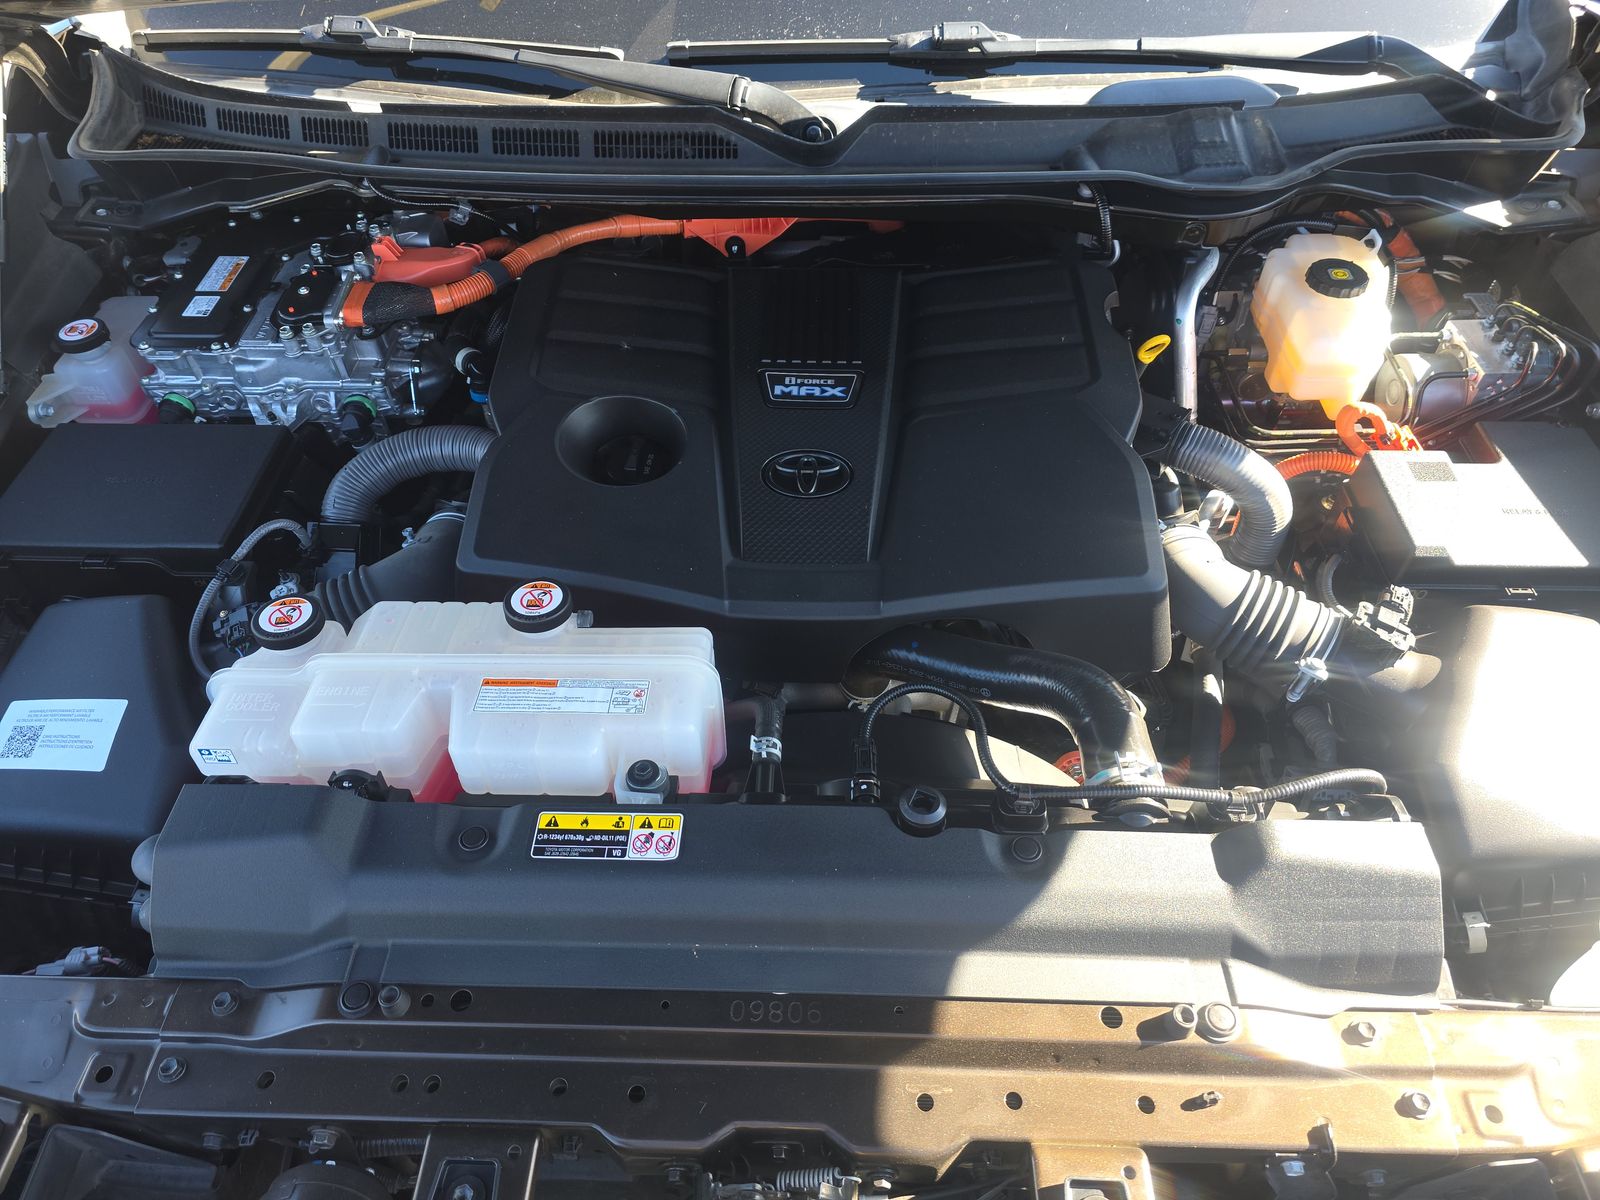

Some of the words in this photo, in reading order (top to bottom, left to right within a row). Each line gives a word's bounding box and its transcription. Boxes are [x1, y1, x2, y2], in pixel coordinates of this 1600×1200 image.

[773, 385, 848, 398] MAX
[317, 686, 370, 696] ENGINE
[230, 692, 274, 702] INTER
[225, 702, 280, 711] COOLER
[612, 849, 622, 857] VG
[730, 1000, 821, 1023] 09806
